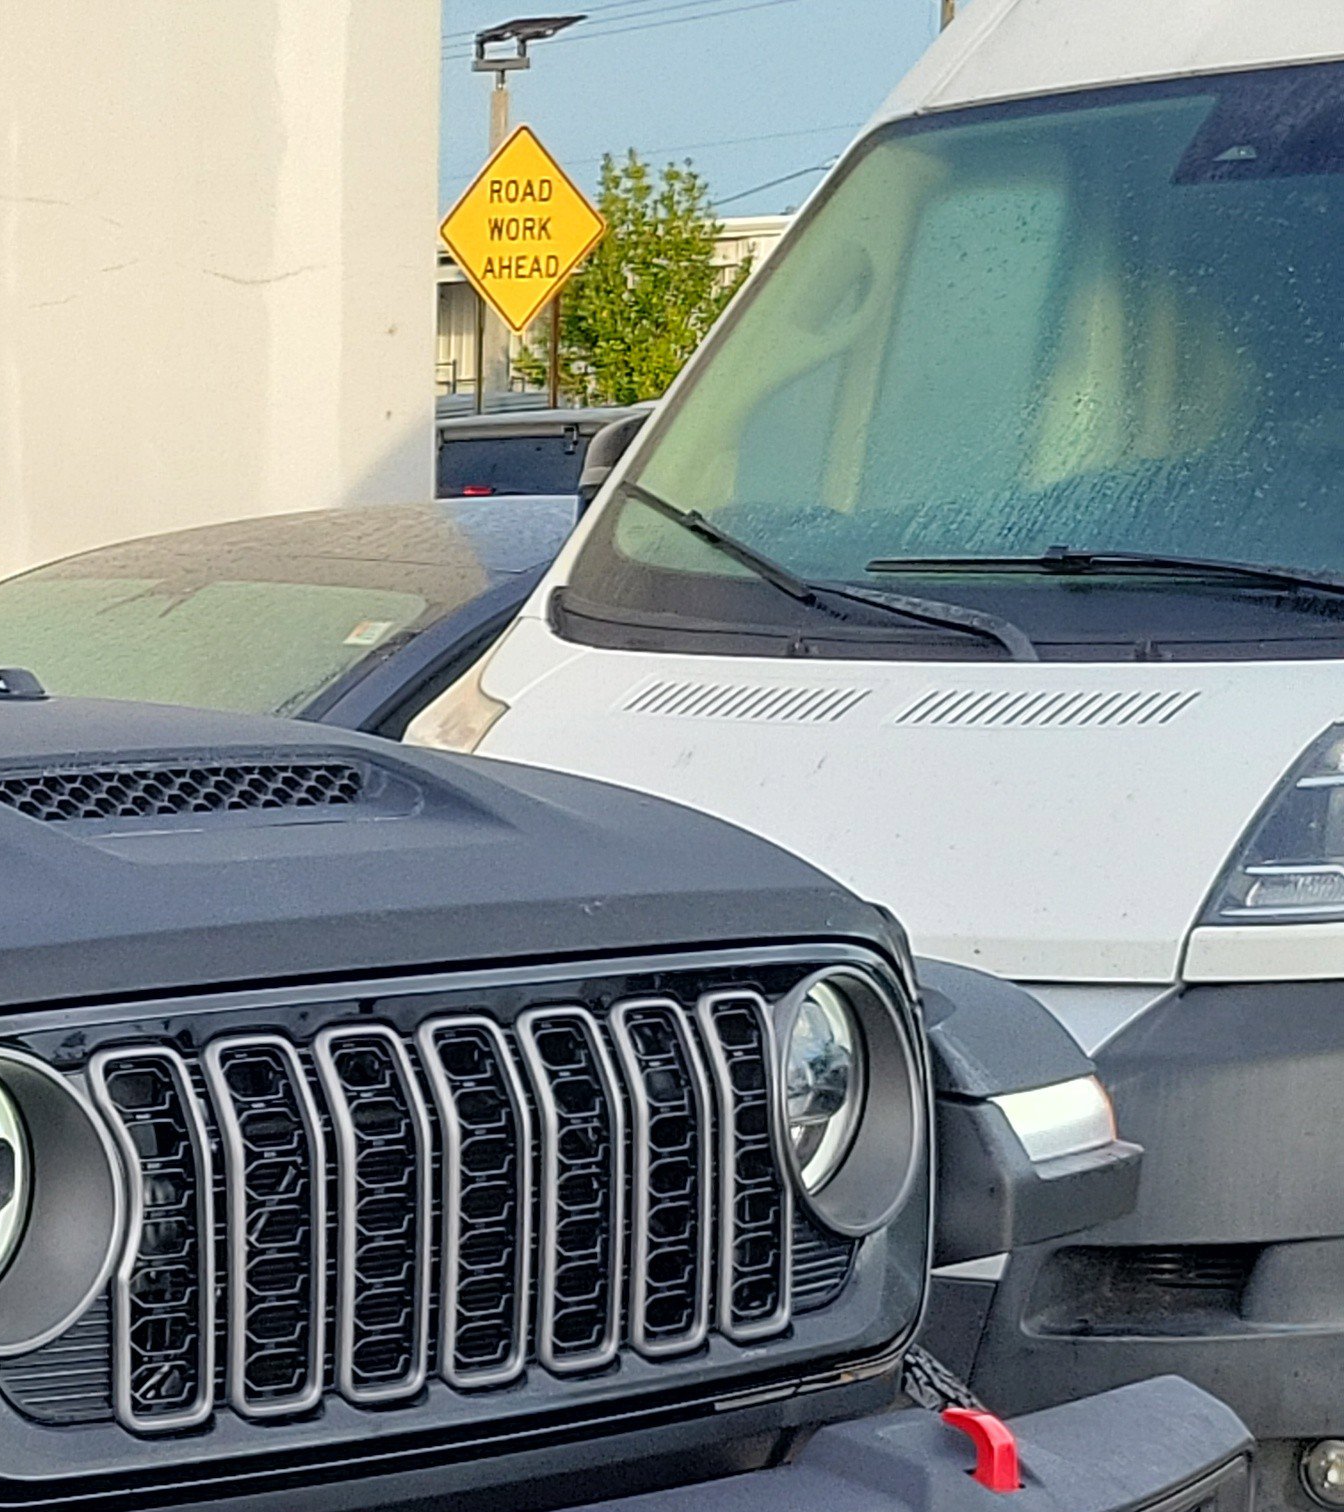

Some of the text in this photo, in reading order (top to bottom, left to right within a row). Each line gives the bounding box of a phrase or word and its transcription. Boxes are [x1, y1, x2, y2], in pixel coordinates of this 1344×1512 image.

[489, 179, 552, 203] ROAD
[489, 217, 552, 241] WORK
[481, 255, 560, 280] AHEAD
